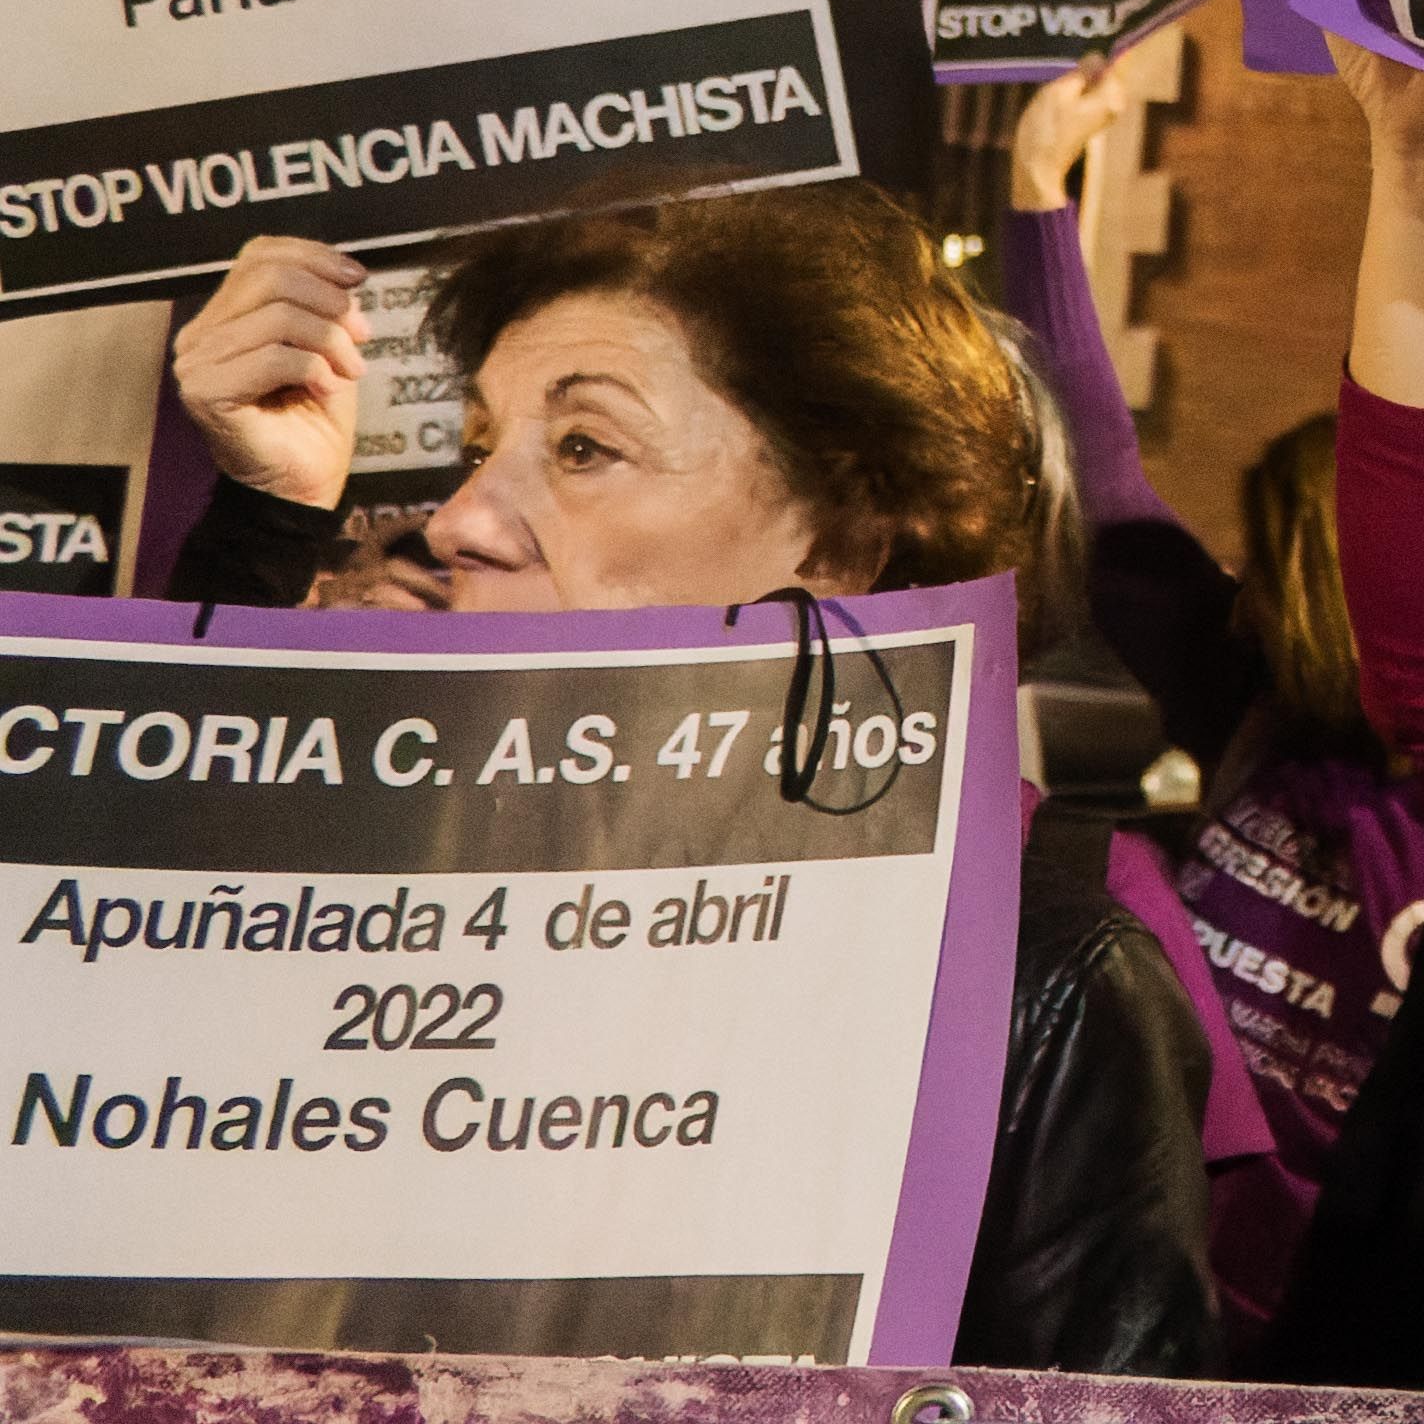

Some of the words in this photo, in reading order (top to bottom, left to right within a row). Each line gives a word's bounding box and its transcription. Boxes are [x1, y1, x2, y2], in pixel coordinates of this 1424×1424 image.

[937, 3, 1037, 39] STOP
[0, 168, 143, 239] STOP
[145, 121, 475, 215] VIOLENCIA
[477, 66, 821, 166] MACHISTA
[372, 717, 454, 787] C.
[476, 714, 631, 784] A.S.
[656, 710, 750, 779] 47
[764, 700, 937, 776] años
[19, 879, 446, 963] Apuñalada
[462, 886, 507, 951] 4
[545, 883, 631, 951] de
[647, 875, 792, 947] abril
[323, 983, 503, 1051] 2022
[11, 1072, 391, 1152] Nohales
[422, 1076, 719, 1153] Cuenca
